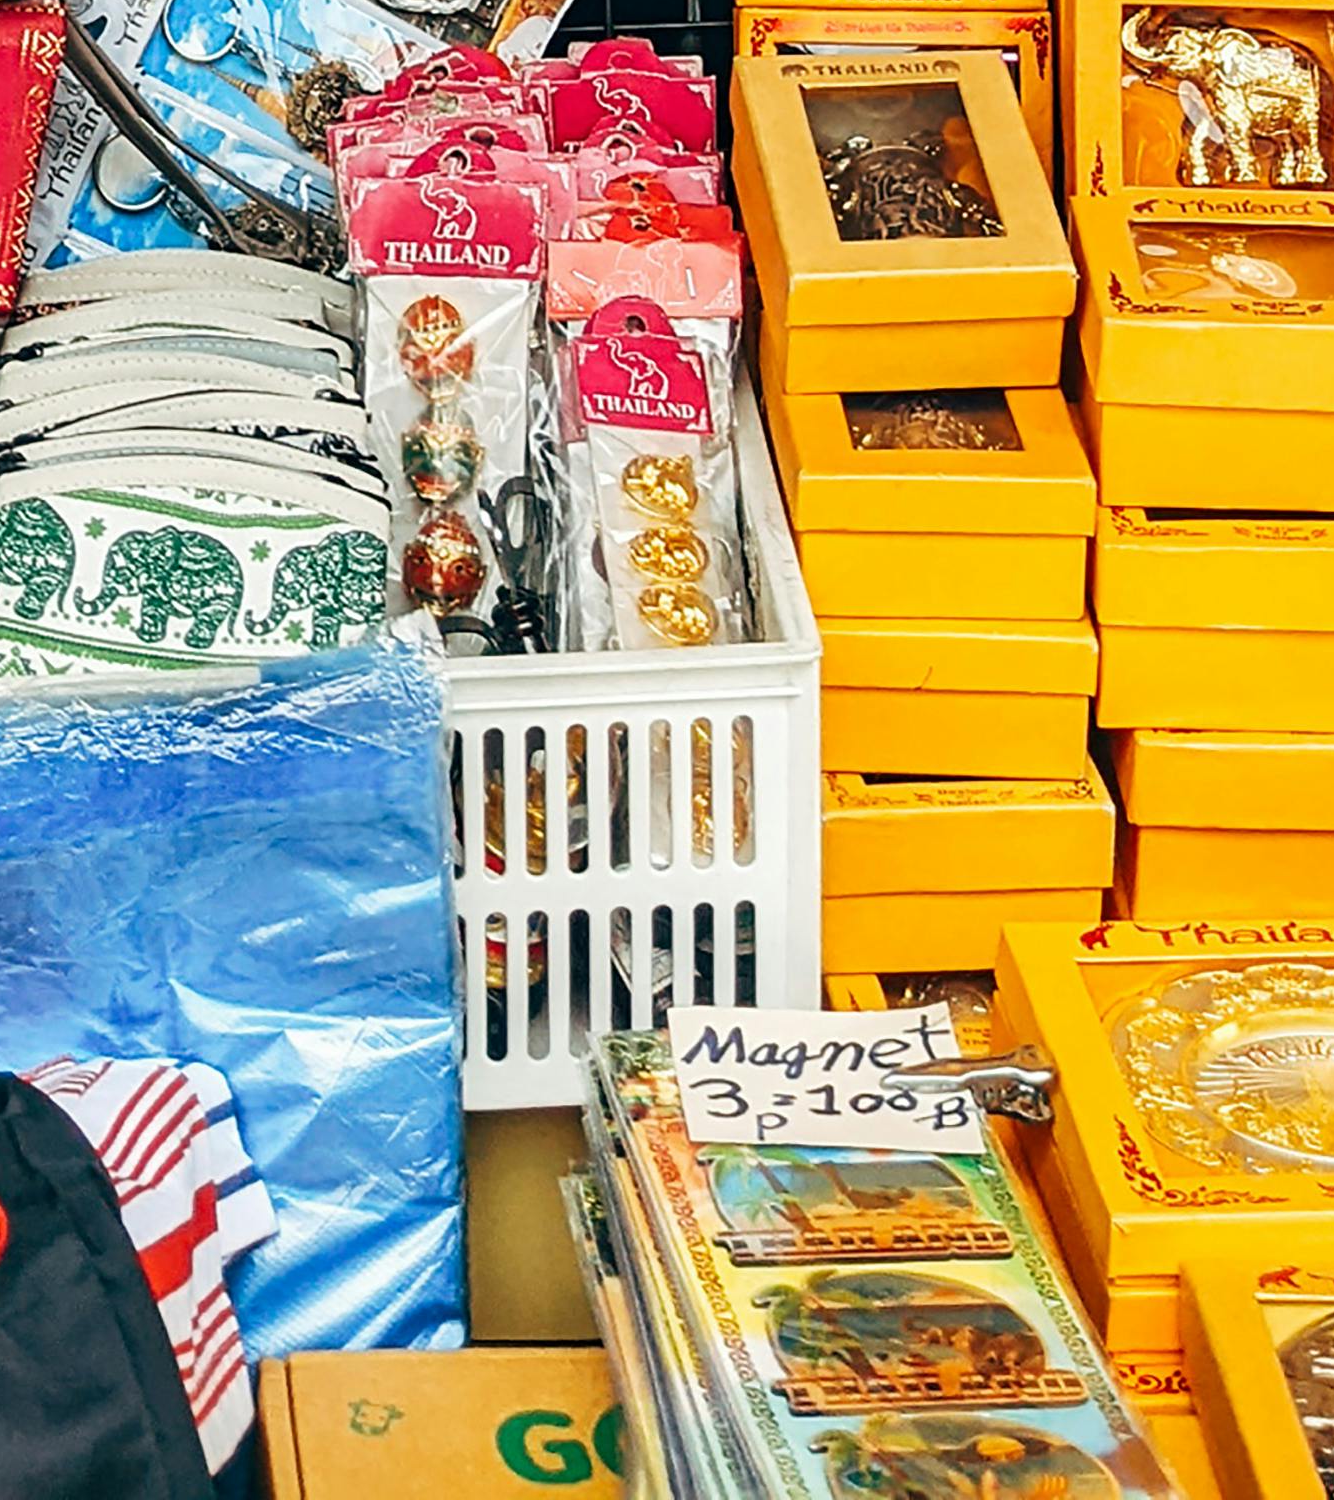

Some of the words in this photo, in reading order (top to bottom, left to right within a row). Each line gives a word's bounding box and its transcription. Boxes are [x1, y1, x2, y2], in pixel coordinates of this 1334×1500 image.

[816, 60, 929, 76] THAILAND
[1166, 198, 1315, 217] Thailand
[383, 241, 511, 266] THAILAND
[592, 393, 695, 419] THAILAND
[681, 1013, 952, 1080] Magnet
